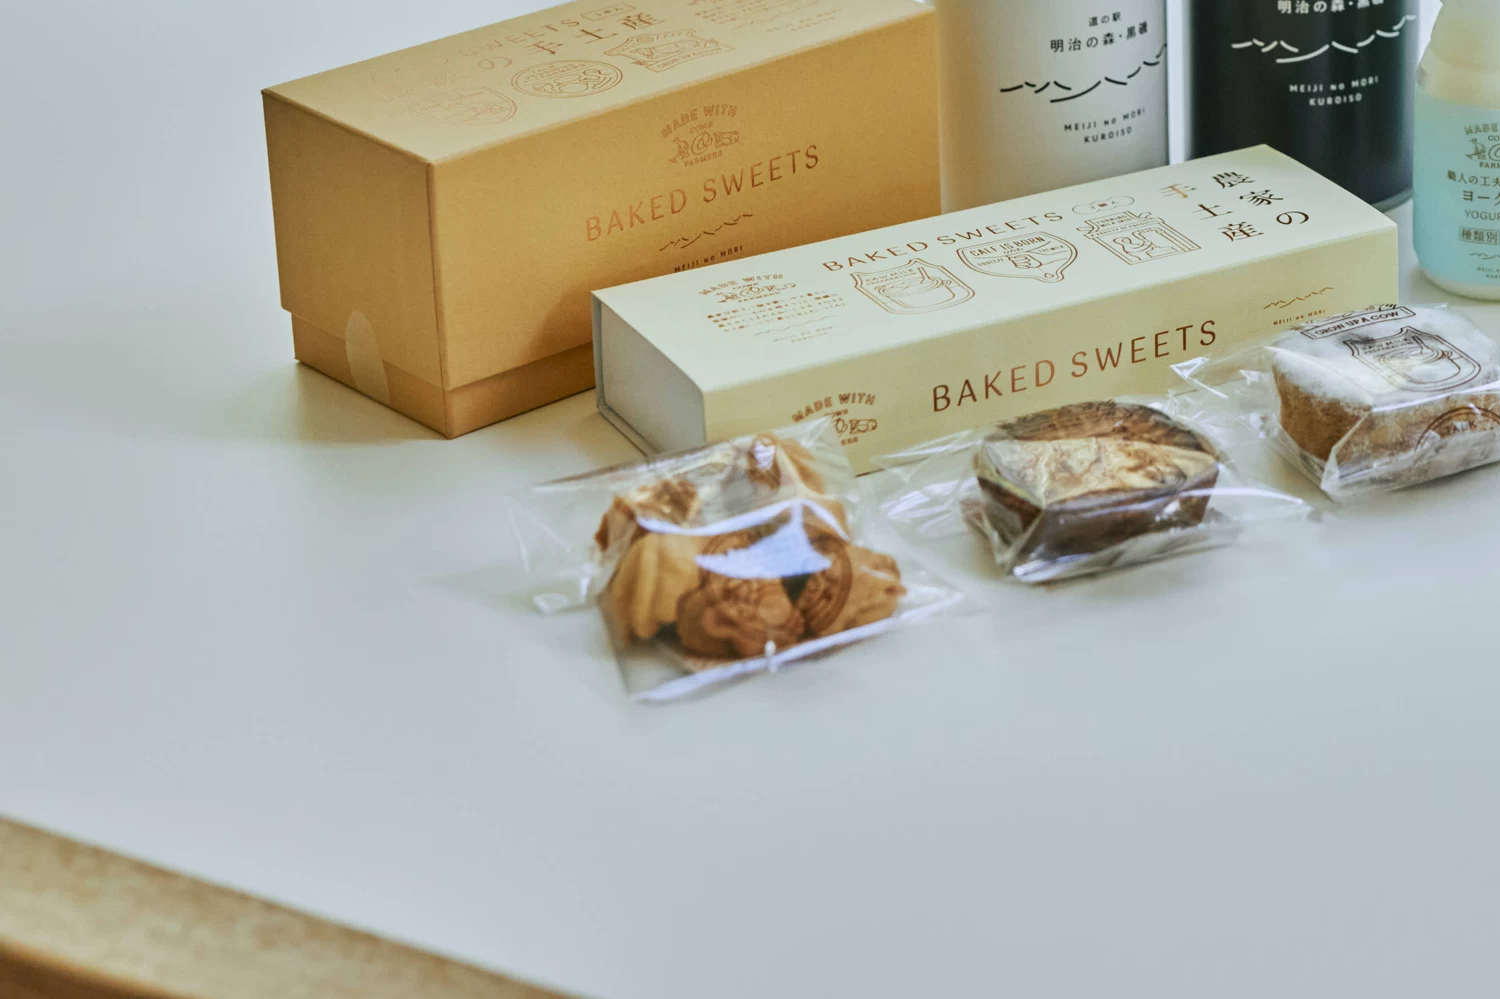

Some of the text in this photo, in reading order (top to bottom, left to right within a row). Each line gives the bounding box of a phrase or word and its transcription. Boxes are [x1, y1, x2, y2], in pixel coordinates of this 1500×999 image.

[1089, 11, 1121, 27] 道の駅
[1289, 84, 1323, 93] MEIJI
[1309, 92, 1362, 106] KUROISO
[661, 104, 738, 139] MADE WITH
[690, 121, 713, 134] COWS
[1064, 121, 1097, 132] MEIJI
[1464, 123, 1498, 135] MADE
[1084, 126, 1132, 143] KUROISO
[684, 150, 723, 168] FARMERS
[585, 144, 819, 242] BAKED SWEETS
[1212, 172, 1309, 225] 農家の
[1159, 183, 1264, 241] 手土産
[822, 211, 1063, 272] BAKED SWEETS
[969, 245, 998, 257] CALF
[1013, 236, 1045, 248] BORN
[674, 259, 700, 273] MEIJI
[720, 245, 743, 259] MORI
[866, 269, 913, 283] RAW MILK
[1345, 319, 1360, 327] UP
[1371, 311, 1399, 321] COW
[932, 320, 1217, 413] BAKED SWEETS
[792, 392, 876, 422] MADE WITH
